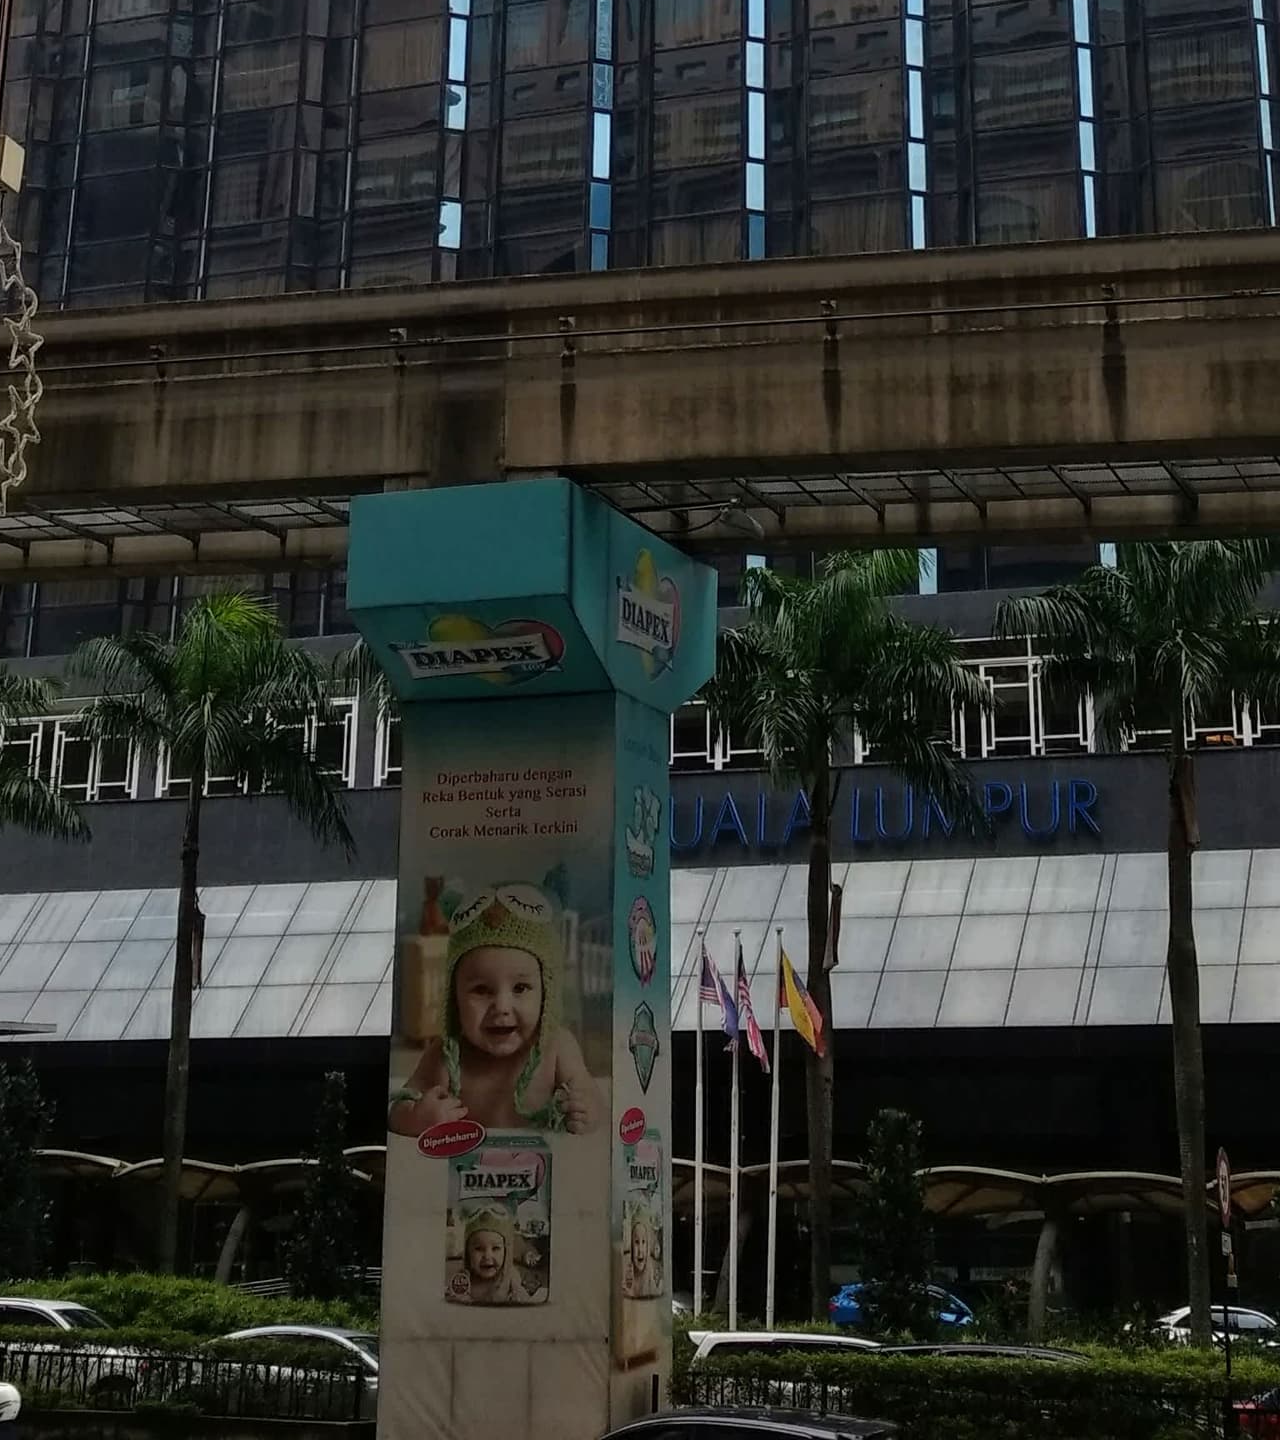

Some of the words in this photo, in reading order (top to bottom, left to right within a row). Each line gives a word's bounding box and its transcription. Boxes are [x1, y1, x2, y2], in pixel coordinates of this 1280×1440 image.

[622, 596, 670, 646] DIAPEX
[409, 644, 542, 668] DIAPEX
[437, 769, 519, 786] Diperbaharu
[523, 767, 573, 783] dengan
[422, 790, 455, 803] Reka
[458, 787, 505, 802] Bentuk
[508, 788, 542, 802] yang
[546, 784, 587, 799] Serasi
[485, 805, 521, 818] Serta
[669, 788, 813, 849] UALA
[429, 824, 470, 839] Corak
[473, 822, 529, 838] Menarik
[532, 820, 579, 835] Terkini
[464, 1173, 532, 1189] DIAPEX
[630, 1165, 656, 1181] DIAPEX
